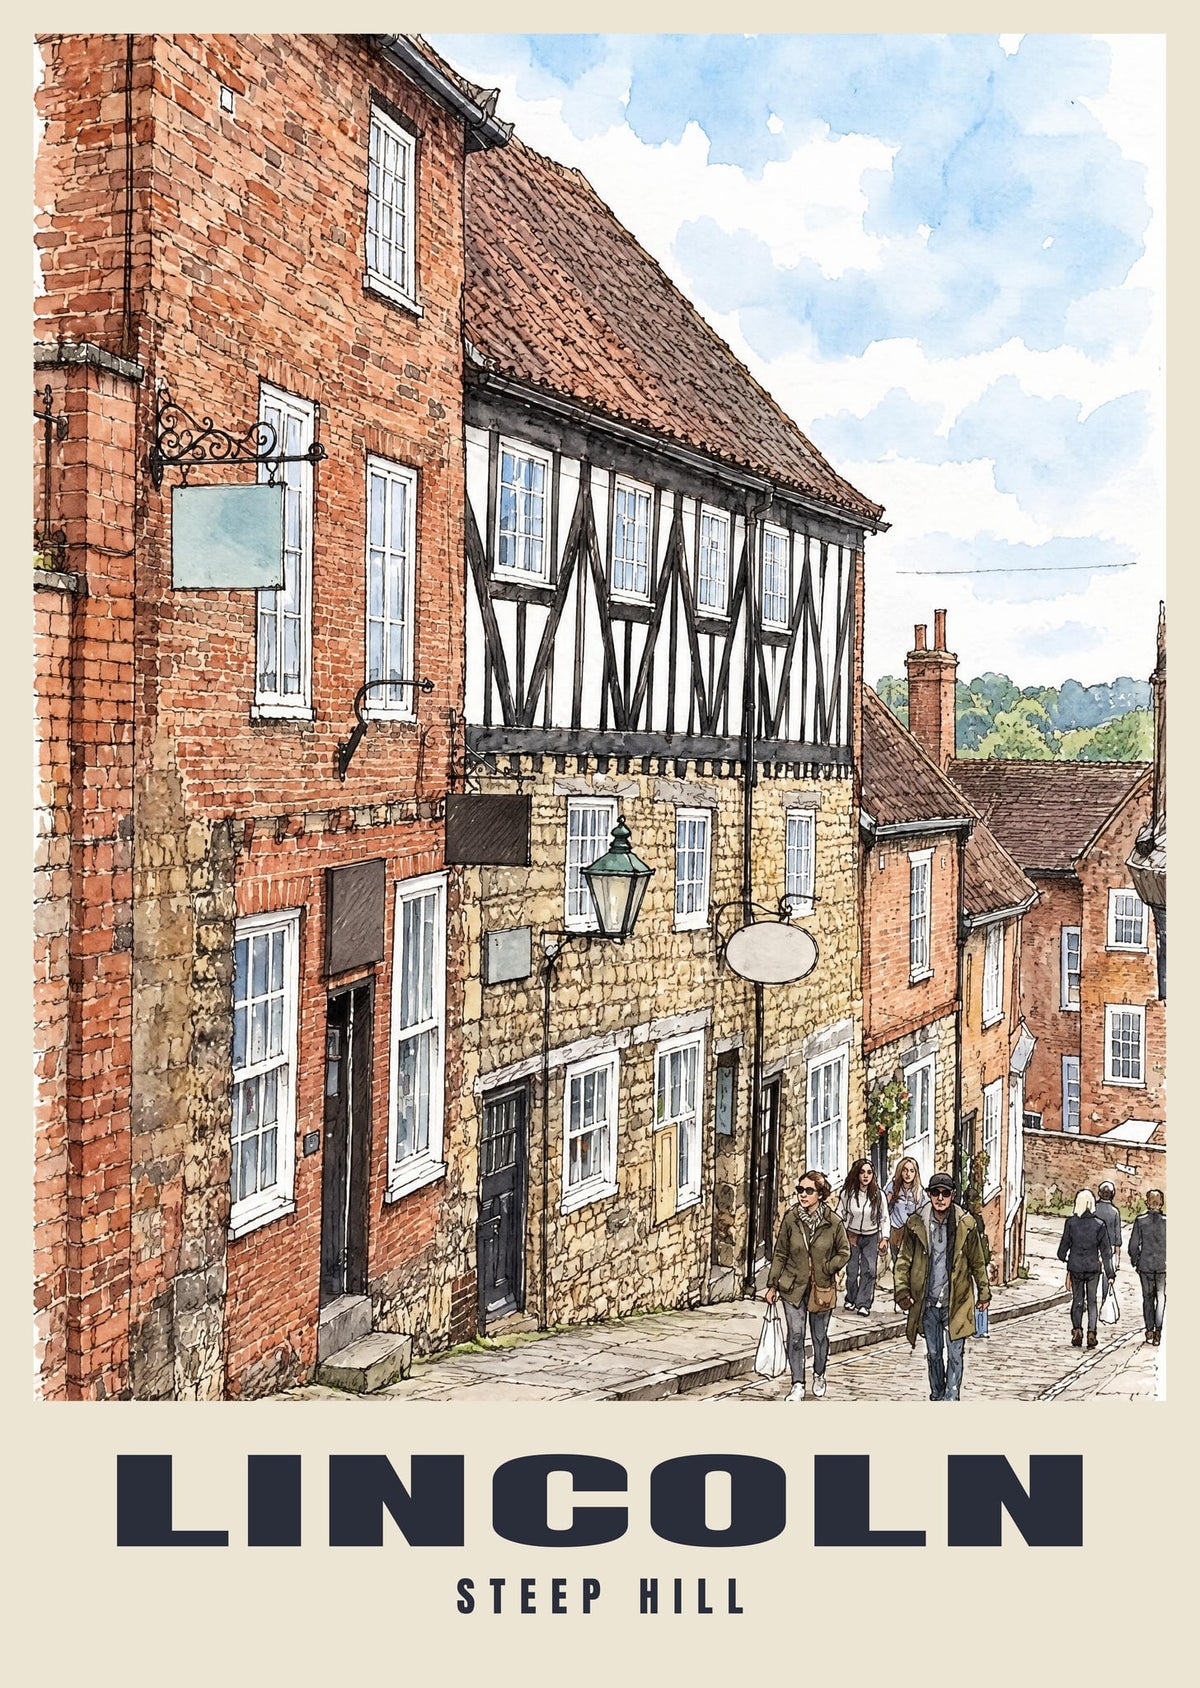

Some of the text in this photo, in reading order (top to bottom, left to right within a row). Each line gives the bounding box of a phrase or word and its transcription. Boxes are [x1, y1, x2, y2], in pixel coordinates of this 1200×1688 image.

[117, 1454, 1083, 1547] LINCOLN
[457, 1578, 744, 1614] STEEP HILL
